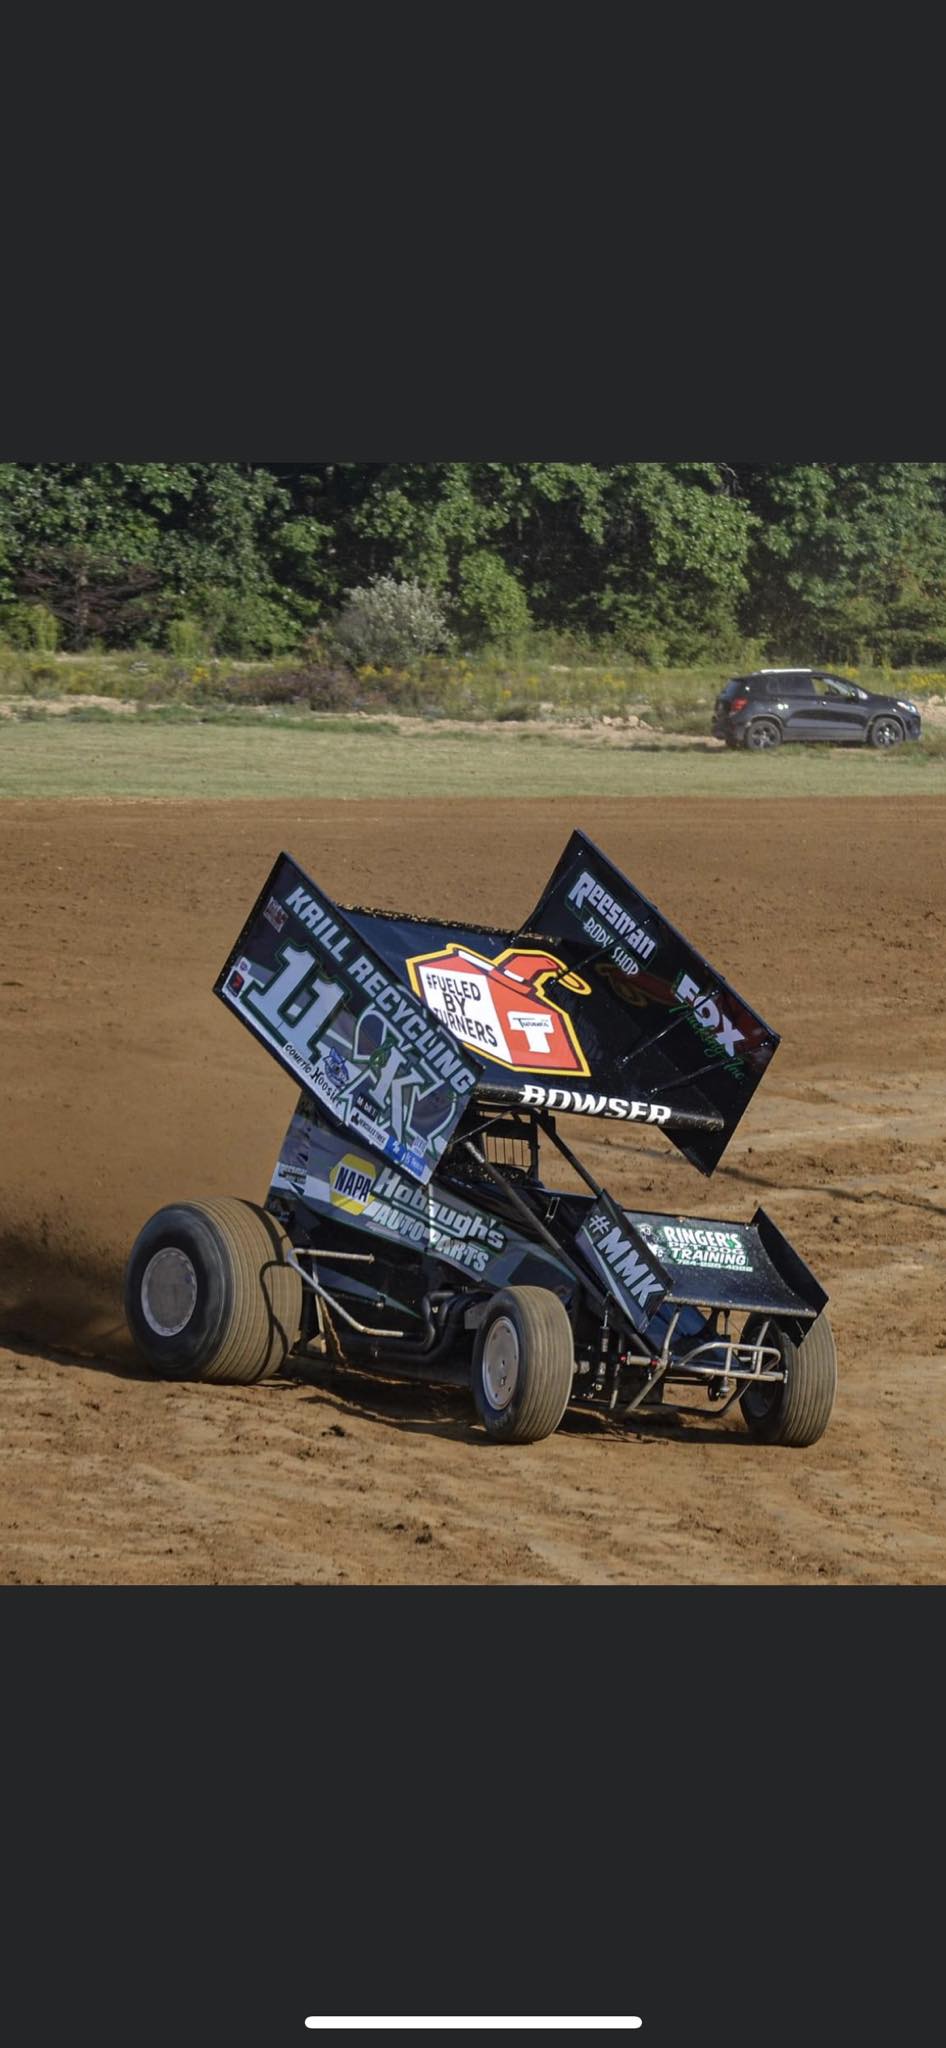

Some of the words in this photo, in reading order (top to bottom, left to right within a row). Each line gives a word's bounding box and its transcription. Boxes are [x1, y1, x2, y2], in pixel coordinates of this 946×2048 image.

[568, 872, 656, 960] Reesman
[583, 917, 614, 948] BODY
[611, 947, 639, 975] SHOP
[285, 886, 351, 962] KRILL
[348, 955, 476, 1095] RECYCLING
[426, 974, 481, 1001] #FUELED
[443, 992, 465, 1016] BY
[675, 974, 746, 1057] FOX
[519, 1084, 671, 1124] BOWSER
[334, 1166, 373, 1203] NAPA
[373, 1167, 504, 1249] Hobaugh's
[372, 1205, 425, 1241] AUTO
[429, 1227, 489, 1272] PARTS
[588, 1214, 664, 1308] #MMK
[663, 1226, 742, 1249] RINGER'S
[671, 1247, 746, 1266] TRAINING
